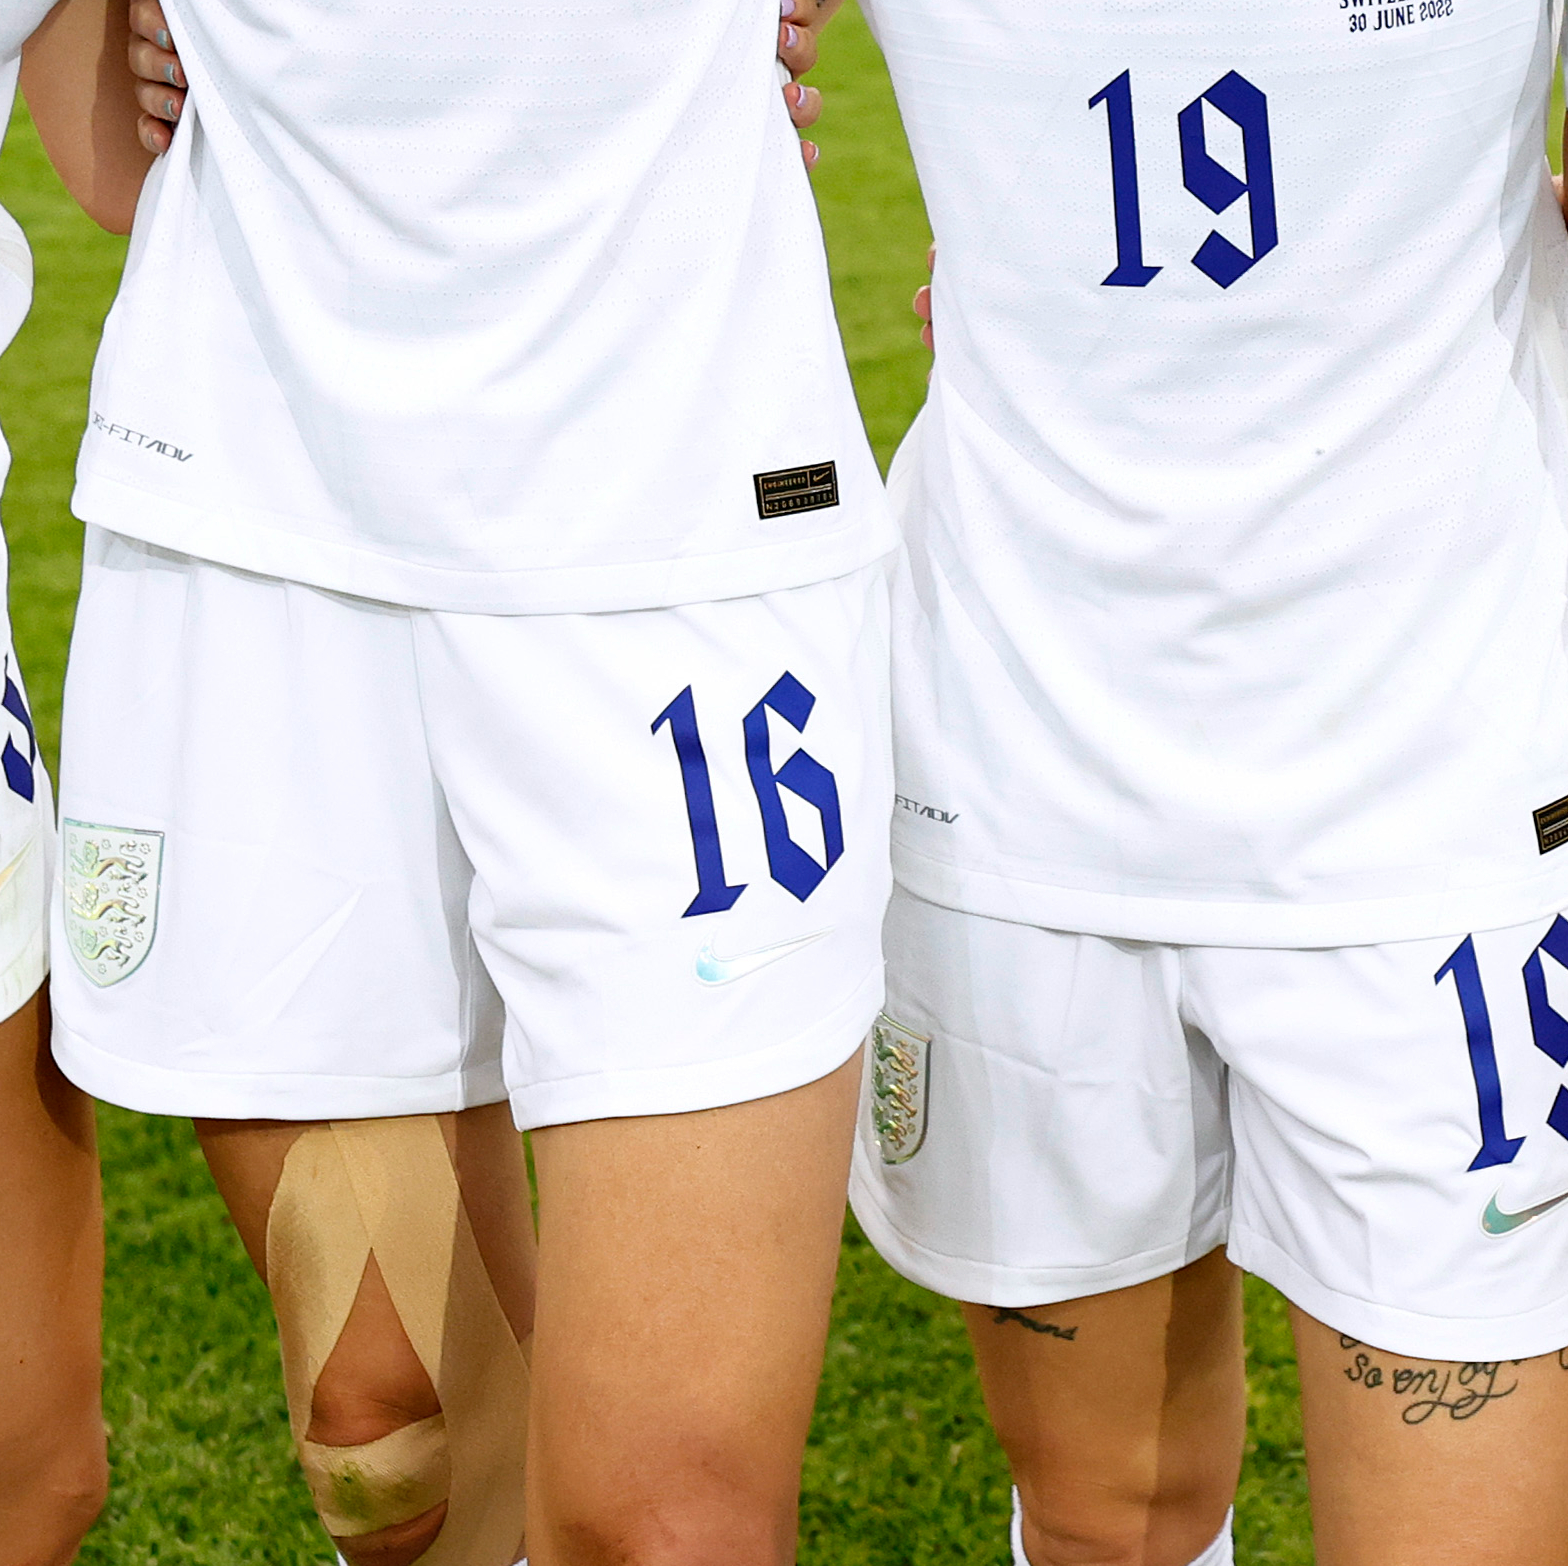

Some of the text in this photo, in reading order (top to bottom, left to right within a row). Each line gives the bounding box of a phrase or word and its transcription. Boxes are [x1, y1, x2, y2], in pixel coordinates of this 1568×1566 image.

[1349, 13, 1367, 33] 30
[1373, 4, 1415, 31] JUNE
[1088, 69, 1279, 289] 19
[650, 670, 845, 919] 16
